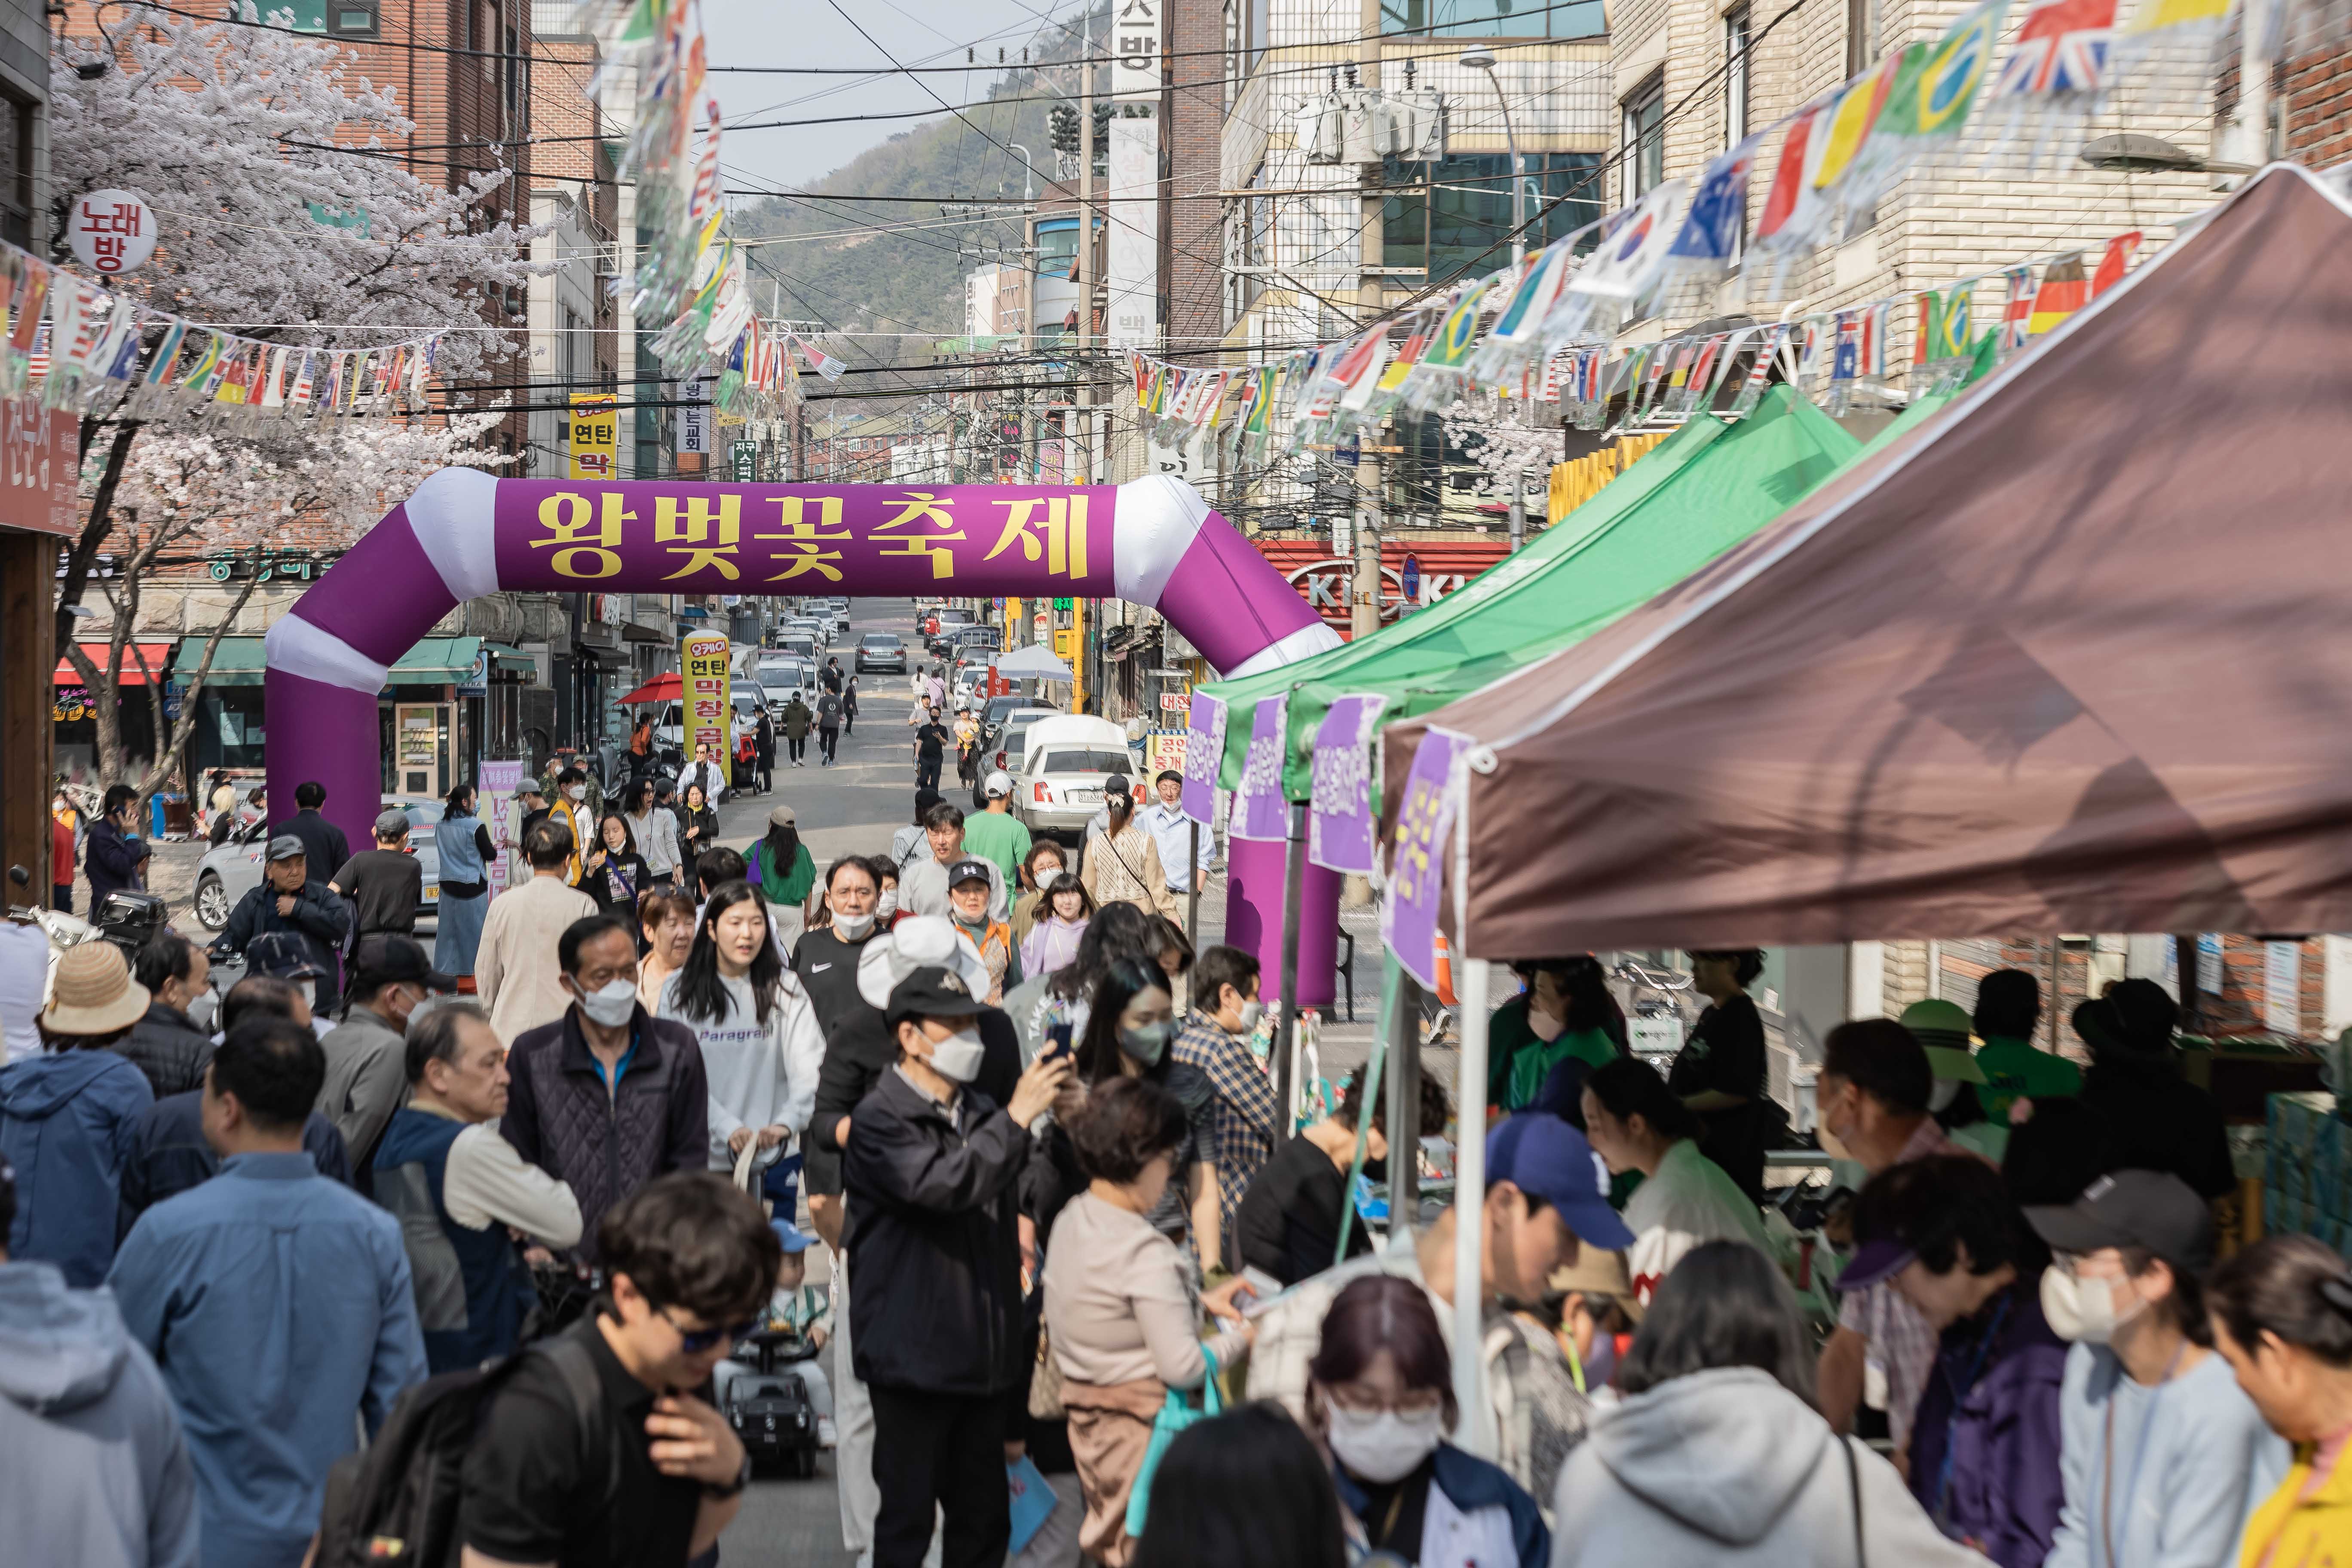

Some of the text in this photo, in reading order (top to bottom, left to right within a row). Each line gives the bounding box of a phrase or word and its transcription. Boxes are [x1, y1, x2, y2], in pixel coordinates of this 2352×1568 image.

[80, 201, 141, 237] 노래
[95, 237, 126, 272] 방
[575, 424, 613, 445] 연탄
[735, 442, 755, 452] 지구
[579, 453, 610, 480] 막
[529, 491, 1090, 582] 왕벚꽃축제
[690, 640, 726, 658] 오케이
[691, 660, 726, 676] 연탄
[1155, 756, 1186, 771] 중개
